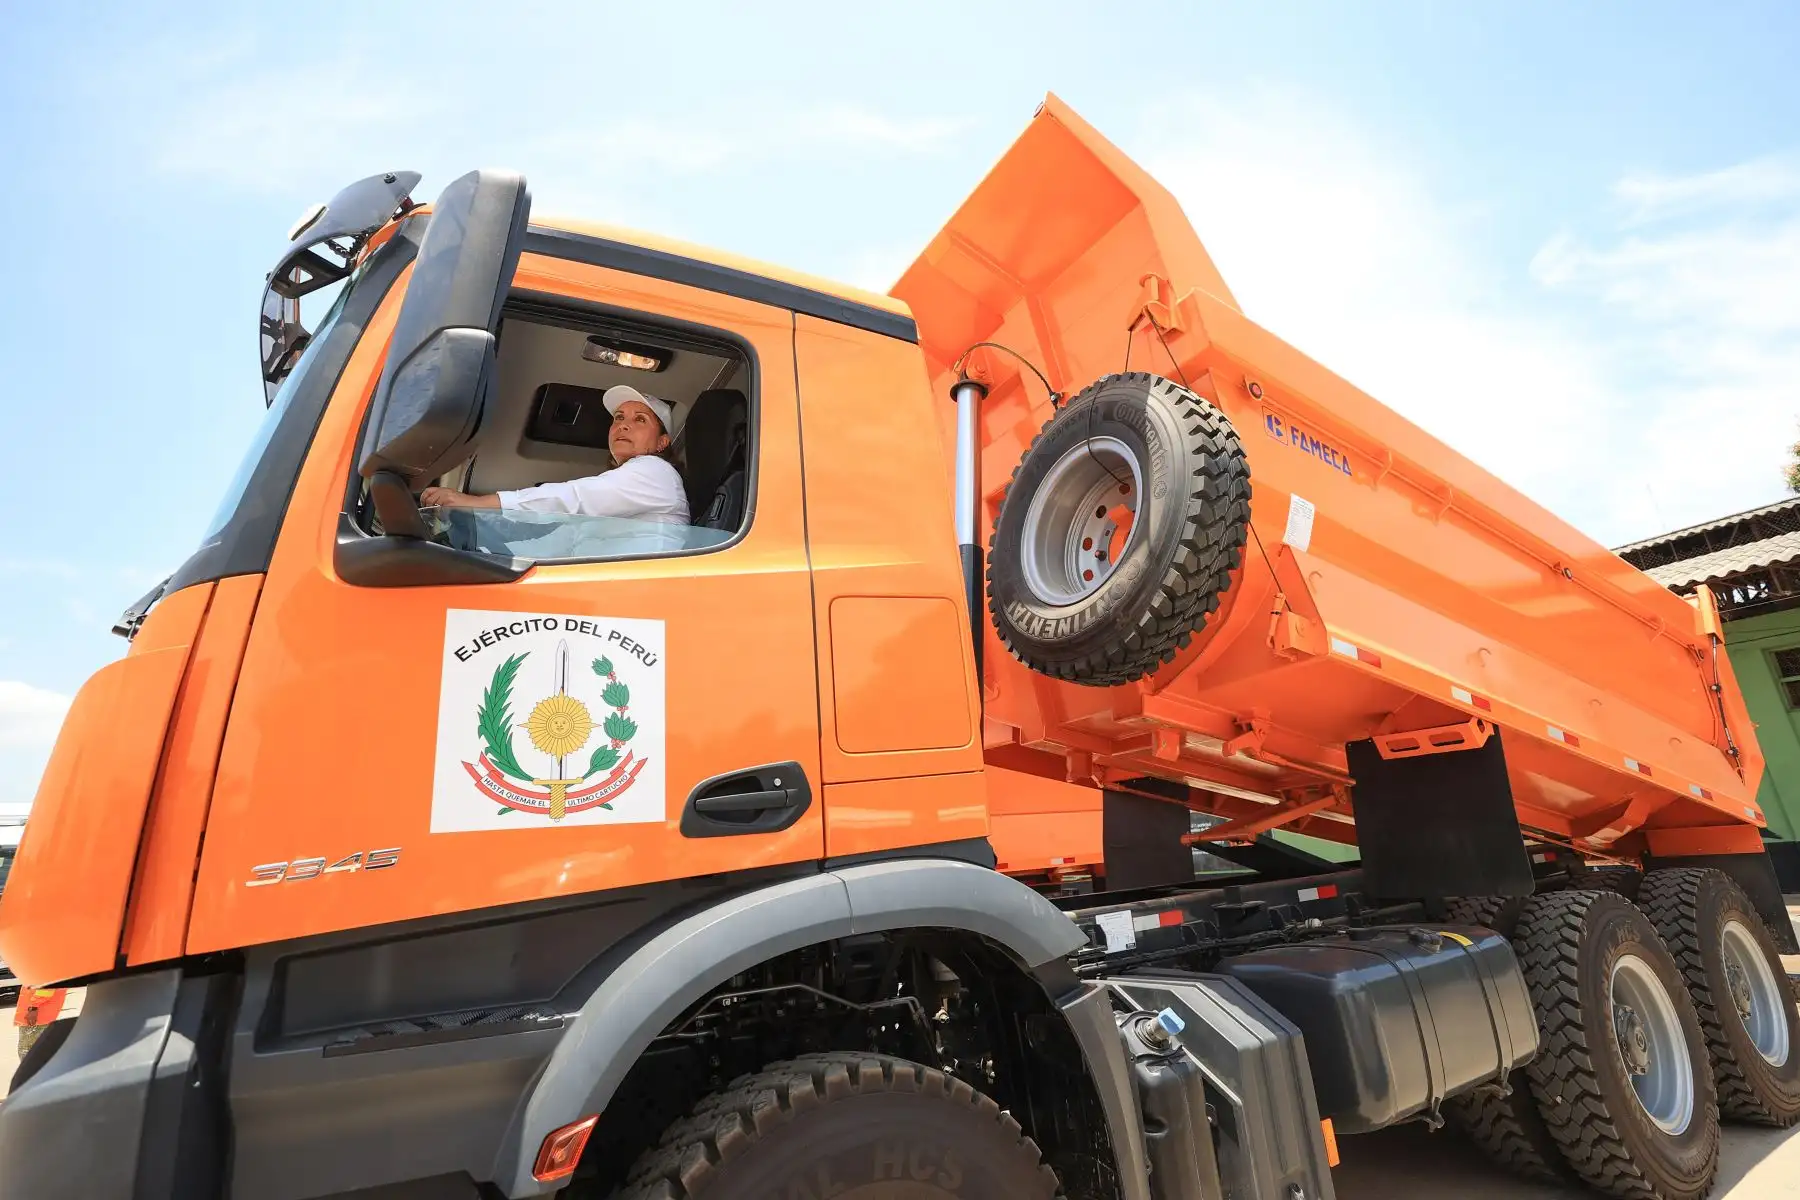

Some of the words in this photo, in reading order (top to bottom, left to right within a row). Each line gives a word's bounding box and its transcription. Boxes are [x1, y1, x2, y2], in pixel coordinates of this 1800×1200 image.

[1290, 425, 1353, 476] FAMECA
[453, 616, 559, 663] EJÉRCITO
[564, 618, 602, 639] DEL
[607, 629, 659, 669] PERÚ
[483, 777, 505, 795] HASTA
[505, 791, 537, 806] QUEMAR
[594, 774, 629, 800] CARTUCHO
[245, 846, 403, 888] 3345
[873, 1141, 963, 1190] HCS
